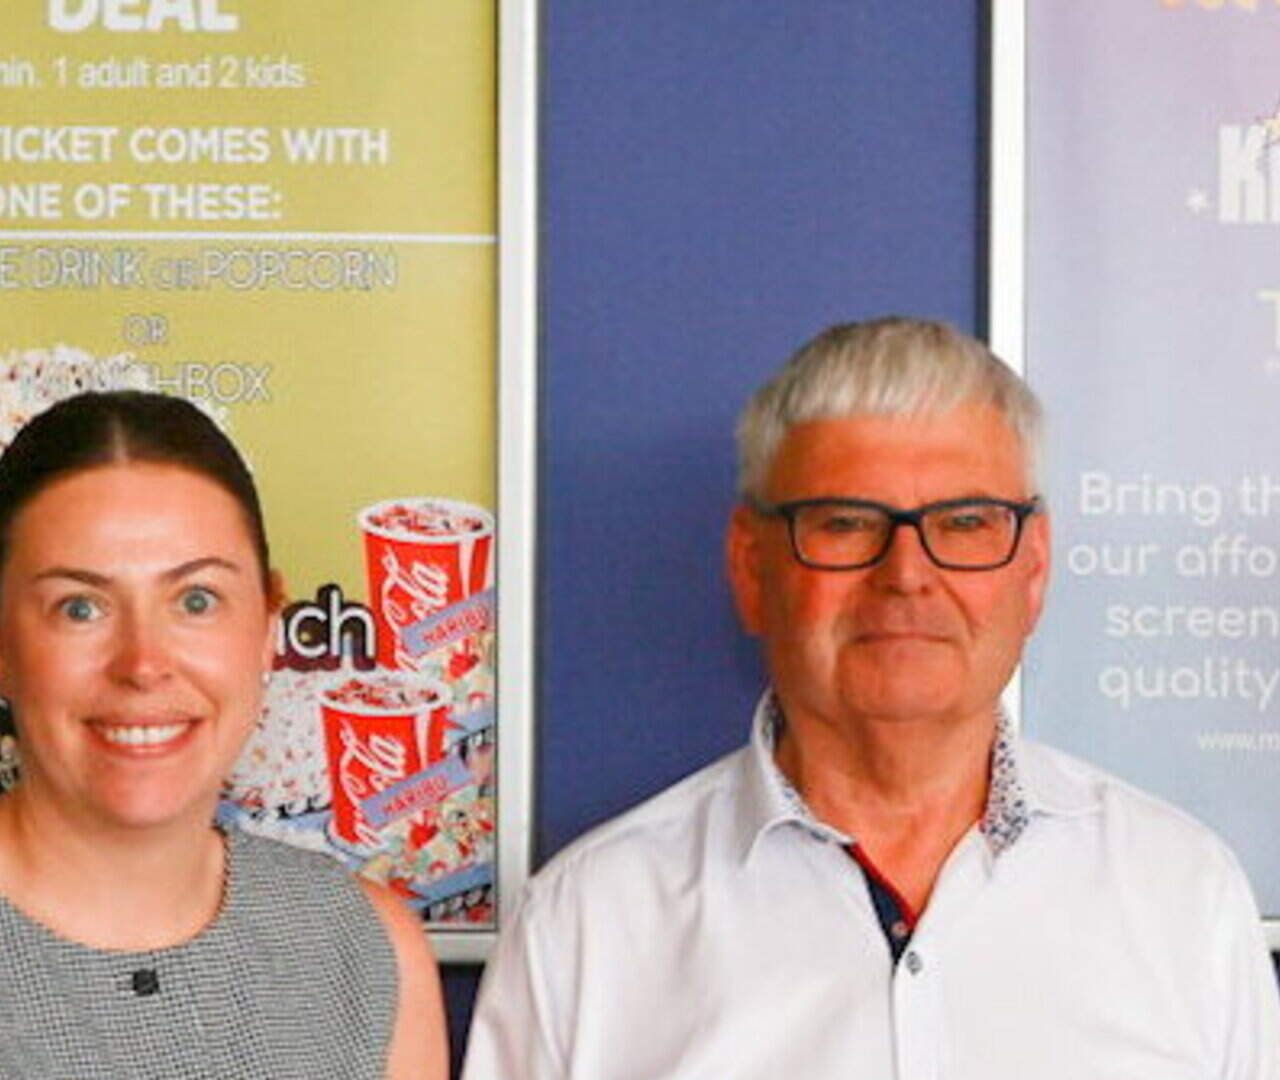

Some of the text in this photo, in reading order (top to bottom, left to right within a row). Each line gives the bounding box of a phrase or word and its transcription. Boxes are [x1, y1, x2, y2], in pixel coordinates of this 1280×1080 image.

[52, 57, 67, 86] 1
[78, 57, 149, 88] adult
[155, 58, 211, 88] and
[218, 56, 242, 88] 2
[245, 57, 306, 88] kids
[128, 127, 271, 164] COMES
[280, 128, 391, 165] WITH
[74, 183, 131, 219] OF
[141, 184, 283, 220] THESE:
[31, 247, 148, 289] DRINK
[200, 247, 399, 290] POPCORN
[122, 315, 168, 344] OR
[1080, 472, 1220, 527] Bring
[1067, 543, 1161, 577] our
